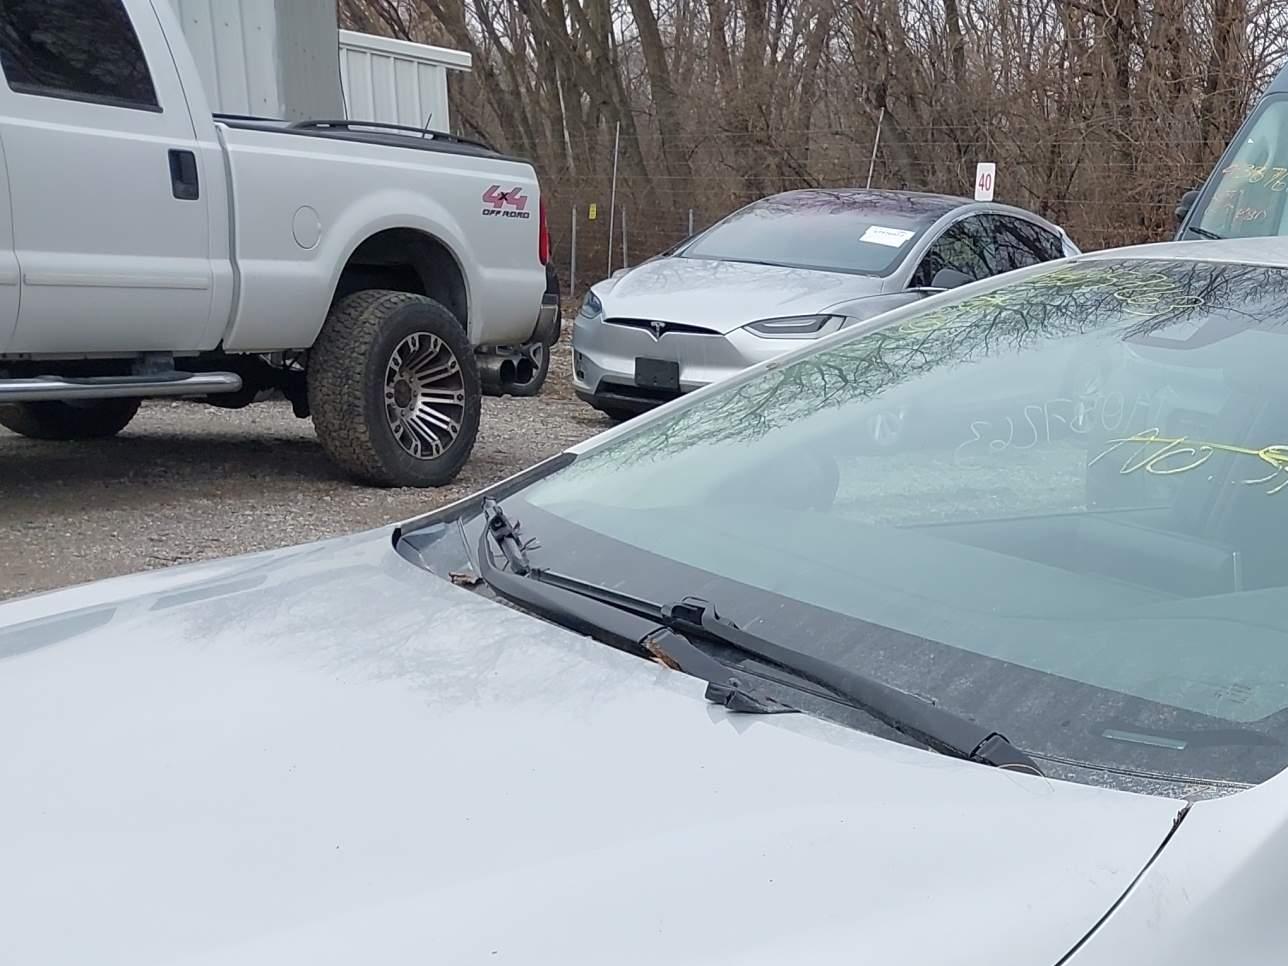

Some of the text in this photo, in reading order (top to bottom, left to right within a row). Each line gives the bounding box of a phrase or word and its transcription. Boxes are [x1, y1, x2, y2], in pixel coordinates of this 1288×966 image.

[978, 173, 992, 191] 40
[482, 208, 530, 219] OFF ROAD
